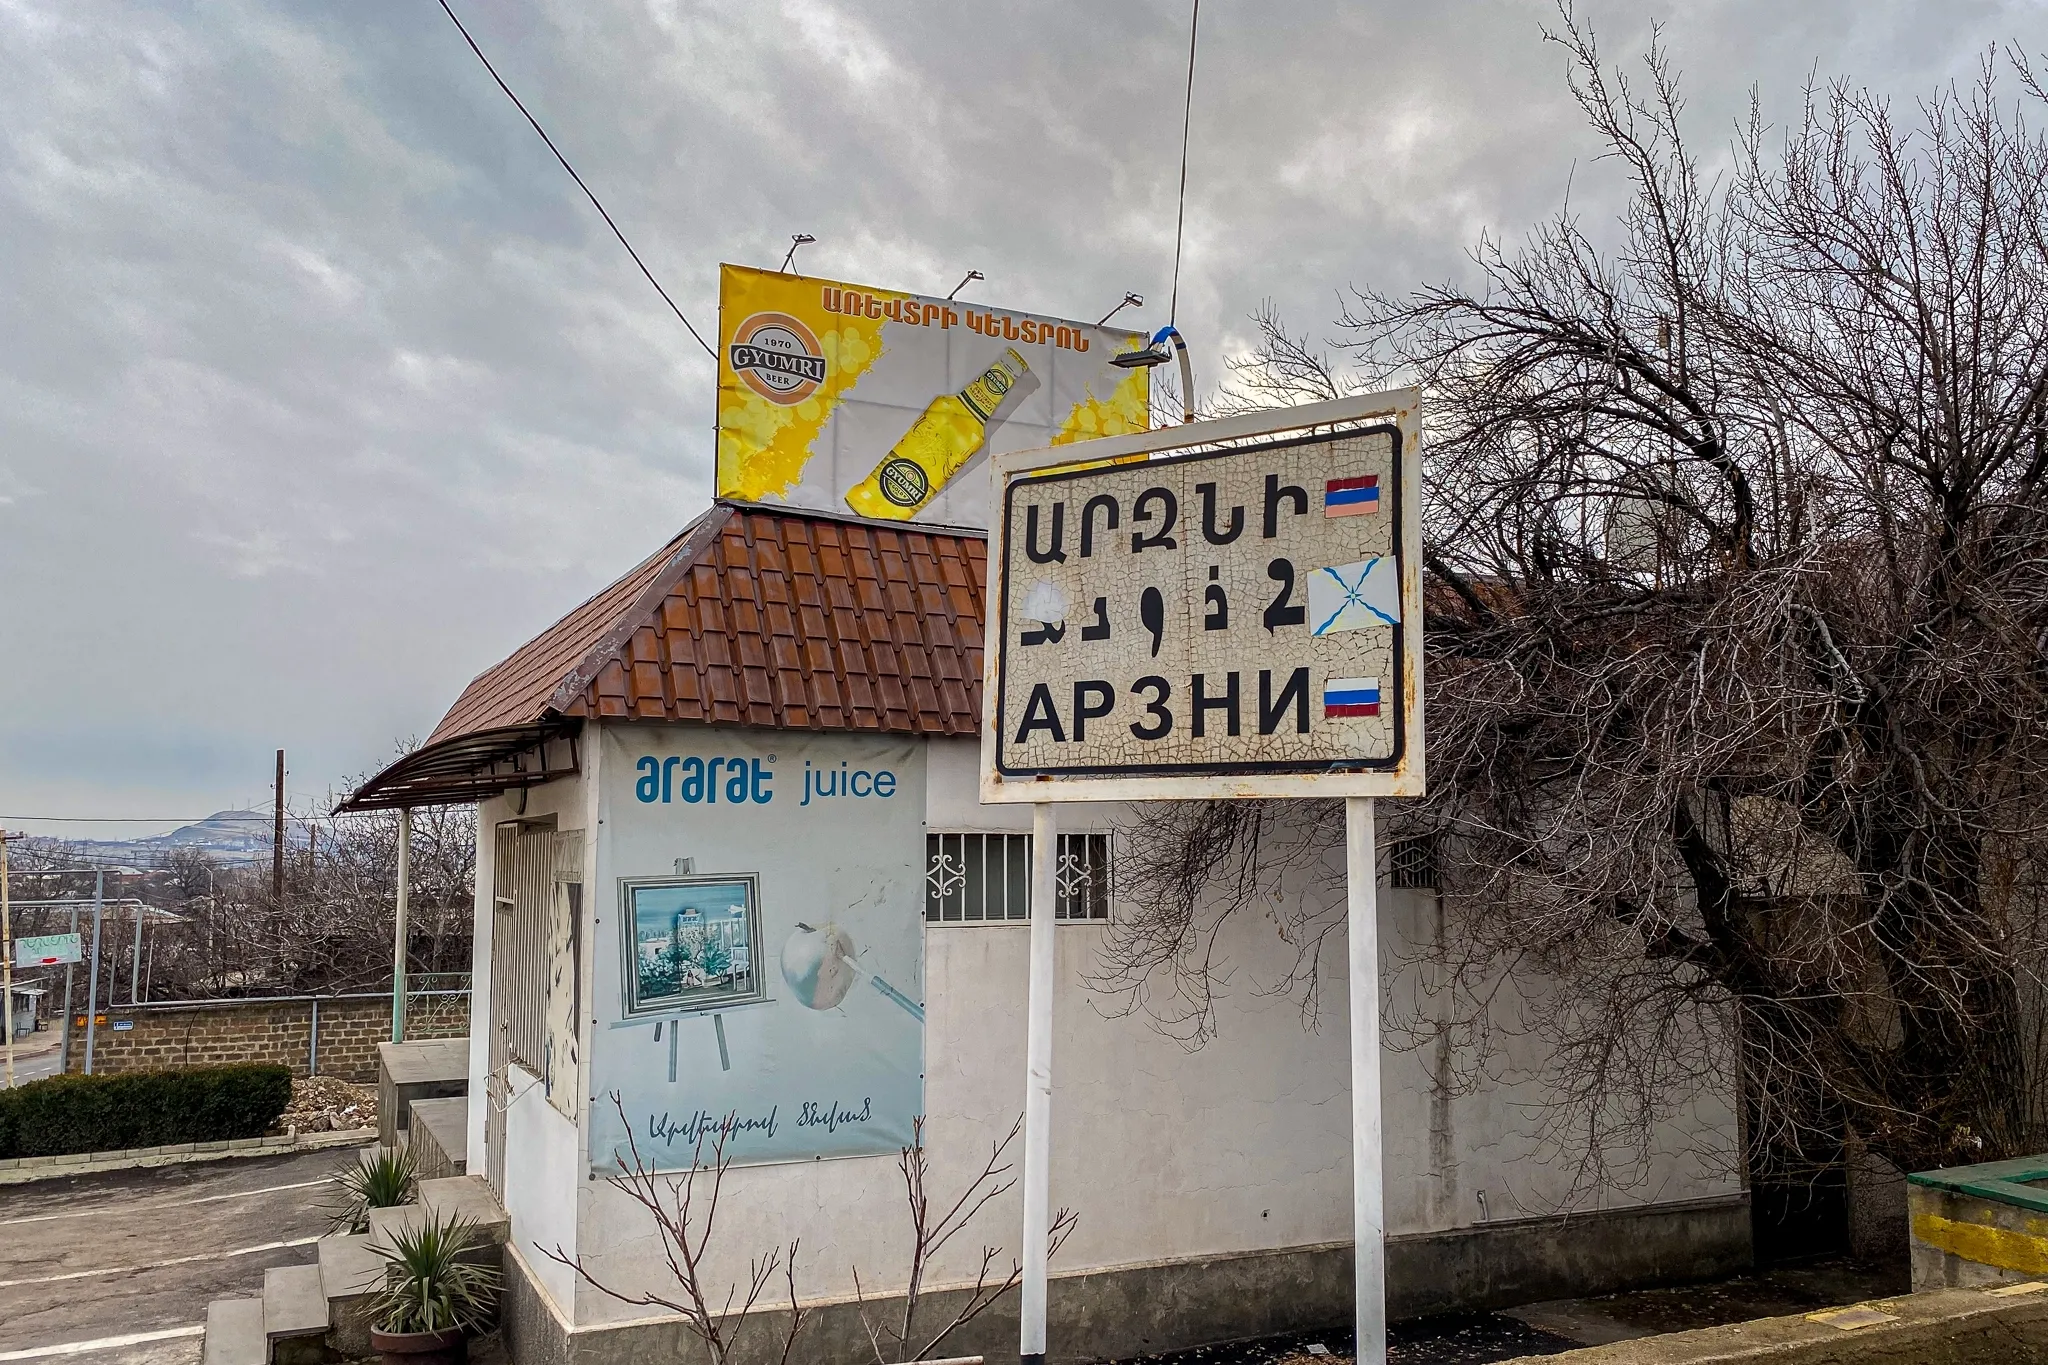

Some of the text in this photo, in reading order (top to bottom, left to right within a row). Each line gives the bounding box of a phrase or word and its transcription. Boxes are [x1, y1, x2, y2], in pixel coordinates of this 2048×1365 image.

[822, 286, 1090, 353] ԱՌԵՎՏՐԻ ԿԵՆՏՐՈՆ
[734, 347, 822, 380] GYUMRI
[765, 338, 792, 349] 1970
[766, 373, 790, 385] BEER
[886, 467, 923, 500] GYUMRI
[1026, 474, 1308, 565] ԱՐԶՆԻ
[1014, 667, 1309, 744] АРЗНИ
[636, 756, 897, 806] ararat juice
